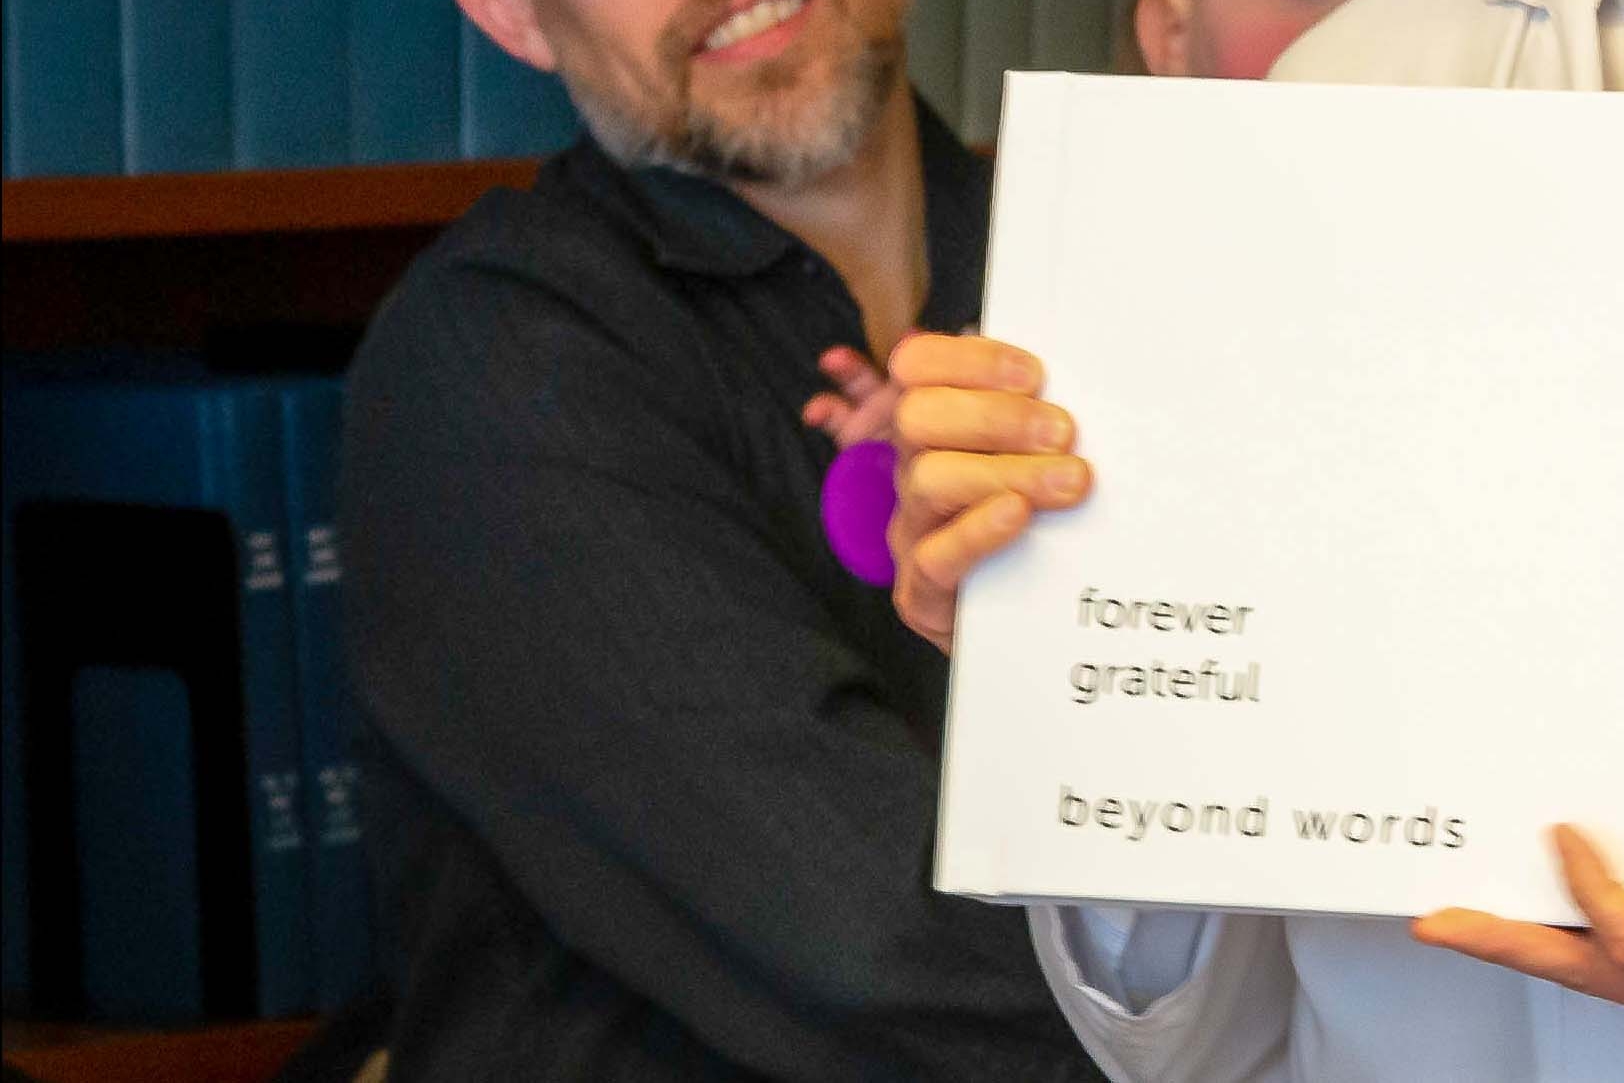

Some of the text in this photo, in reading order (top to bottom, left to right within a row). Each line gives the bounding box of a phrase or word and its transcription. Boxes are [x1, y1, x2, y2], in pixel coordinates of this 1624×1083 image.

[1077, 587, 1255, 635] forever
[1069, 660, 1261, 705] grateful
[1058, 783, 1467, 849] beyond words
